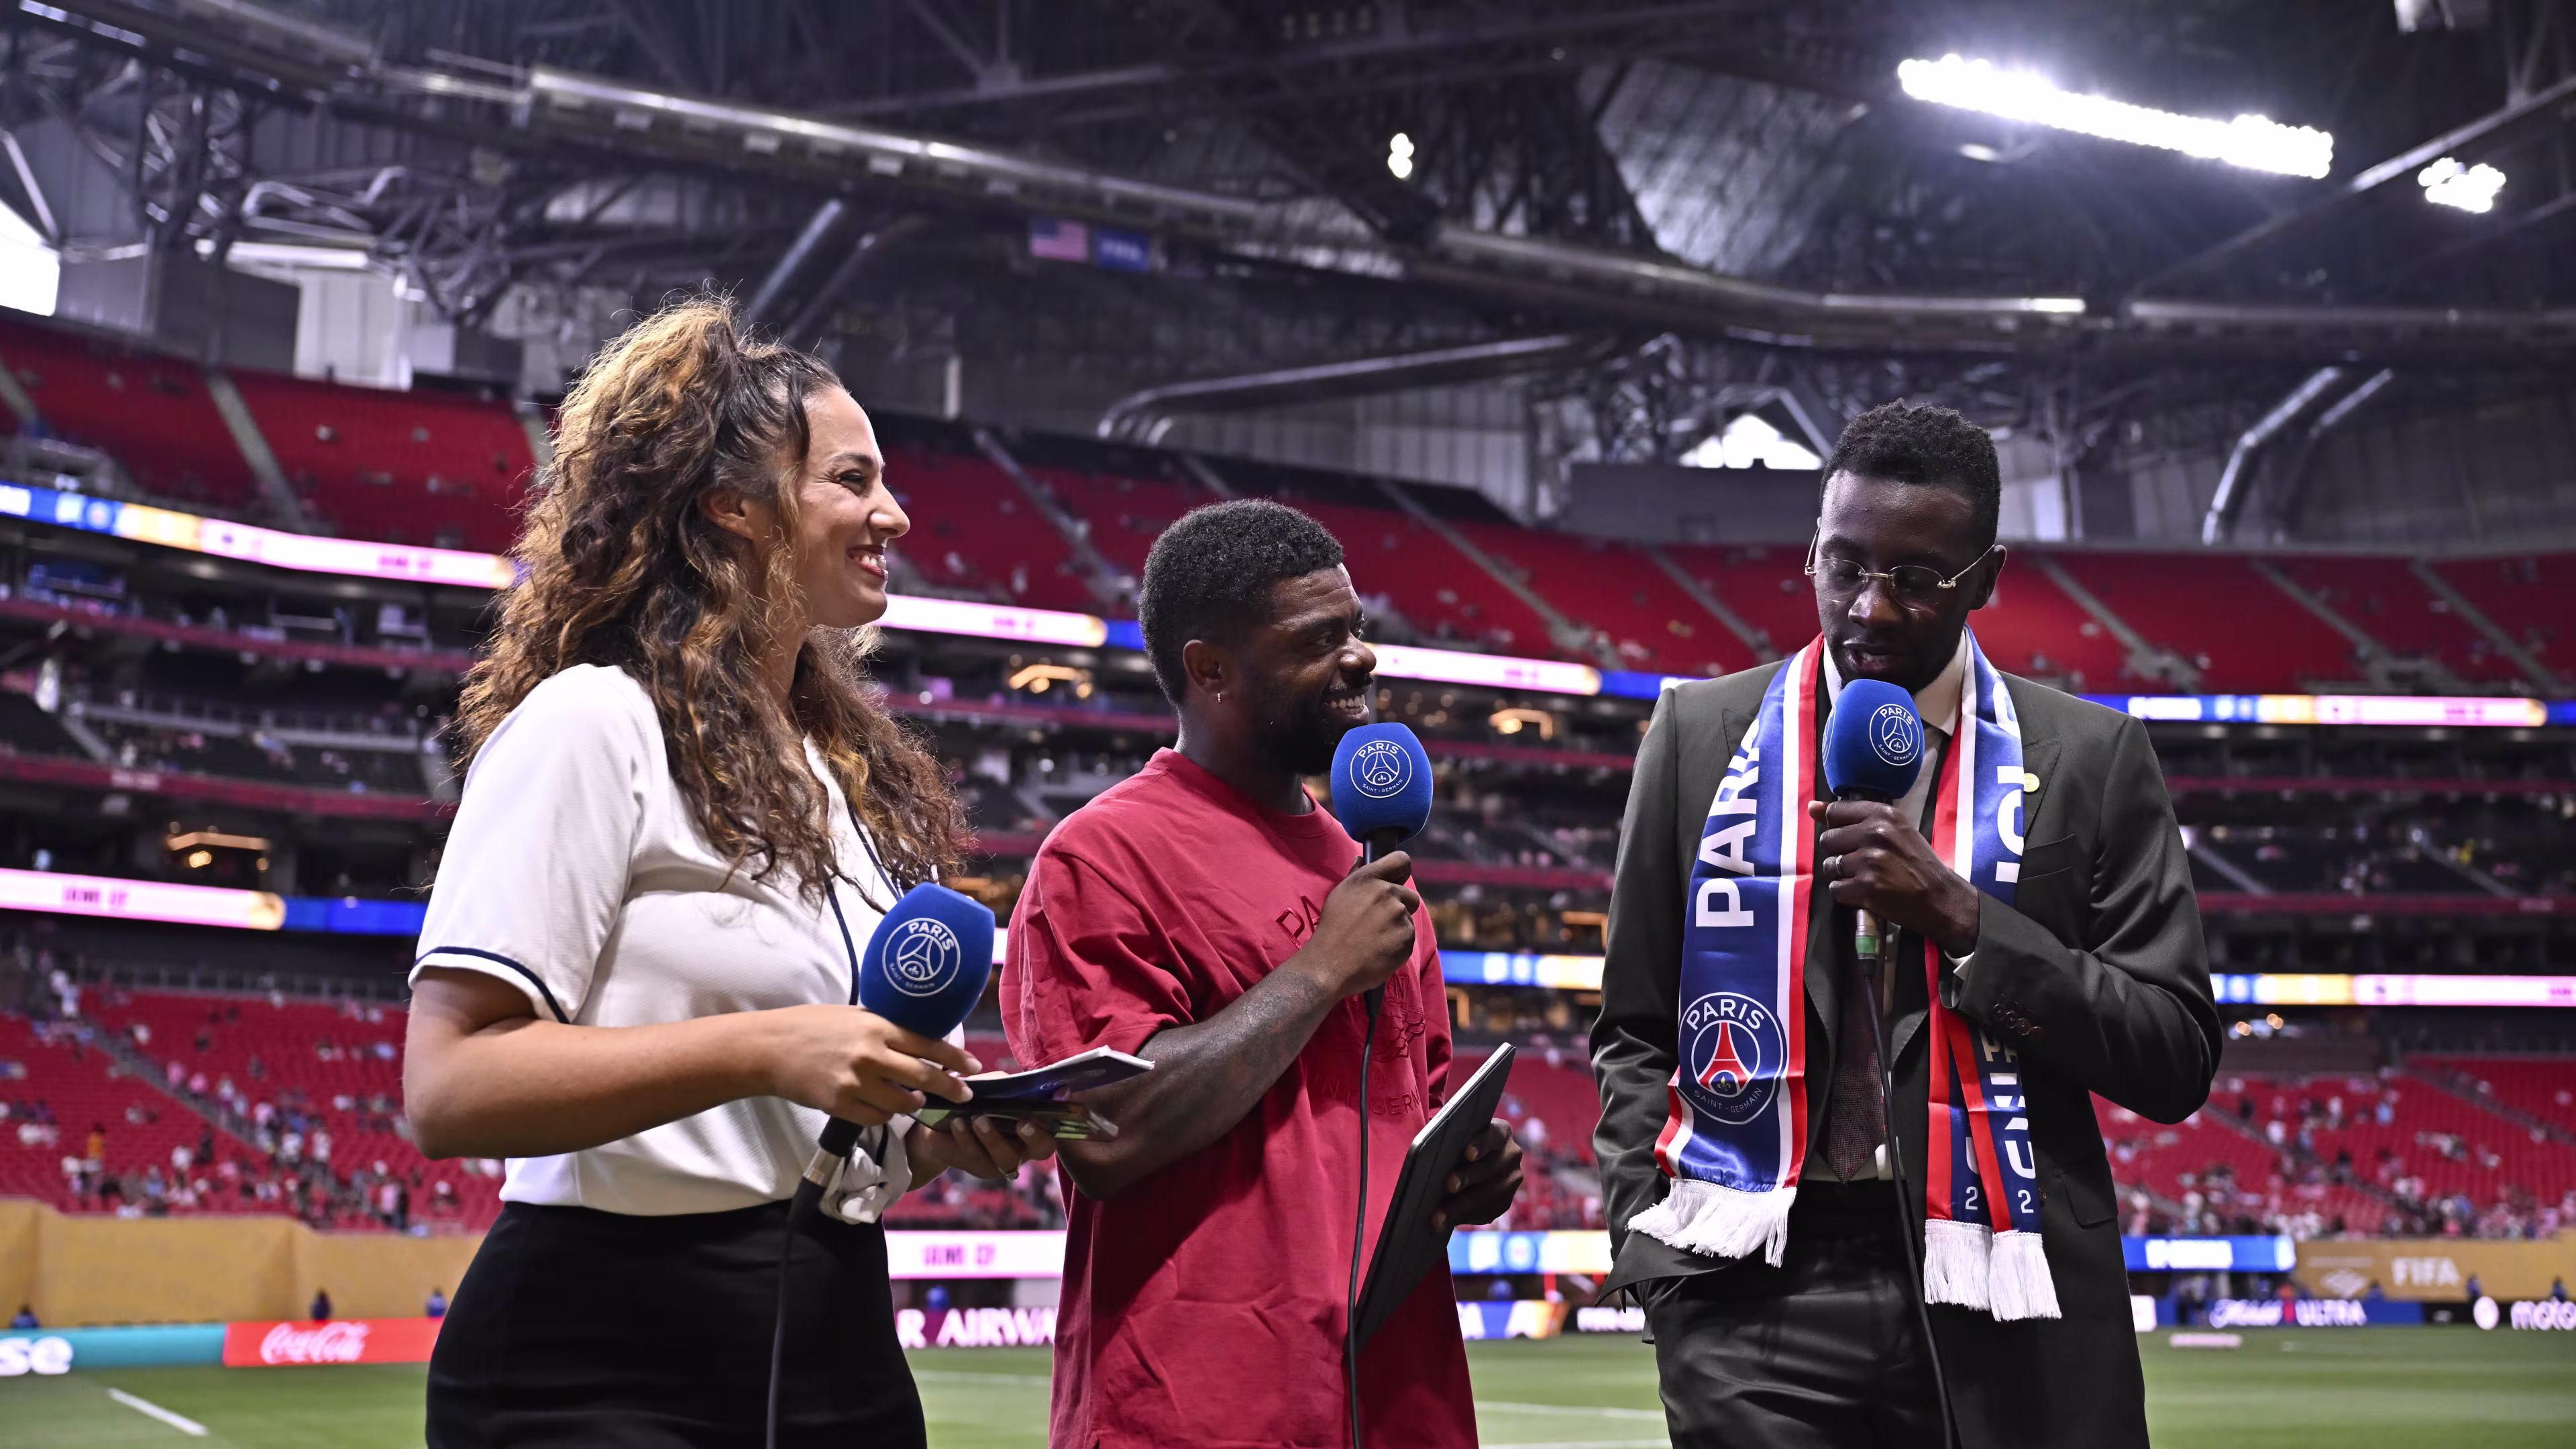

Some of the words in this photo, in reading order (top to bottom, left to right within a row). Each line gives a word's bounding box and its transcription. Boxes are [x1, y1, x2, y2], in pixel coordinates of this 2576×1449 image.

[1880, 707, 1913, 725] PARIS
[1358, 743, 1399, 758] PARIS
[1878, 744, 1890, 757] SAINT
[1893, 752, 1912, 761] GERMAIN
[1362, 784, 1377, 793] SAINT
[1382, 779, 1403, 793] GERMAIN
[908, 922, 955, 951] PARIS
[1686, 999, 1764, 1030] PARIS
[1371, 1088, 1421, 1116] GERM
[1694, 1090, 1723, 1110] SAINT
[1730, 1087, 1762, 1113] GERMAIN
